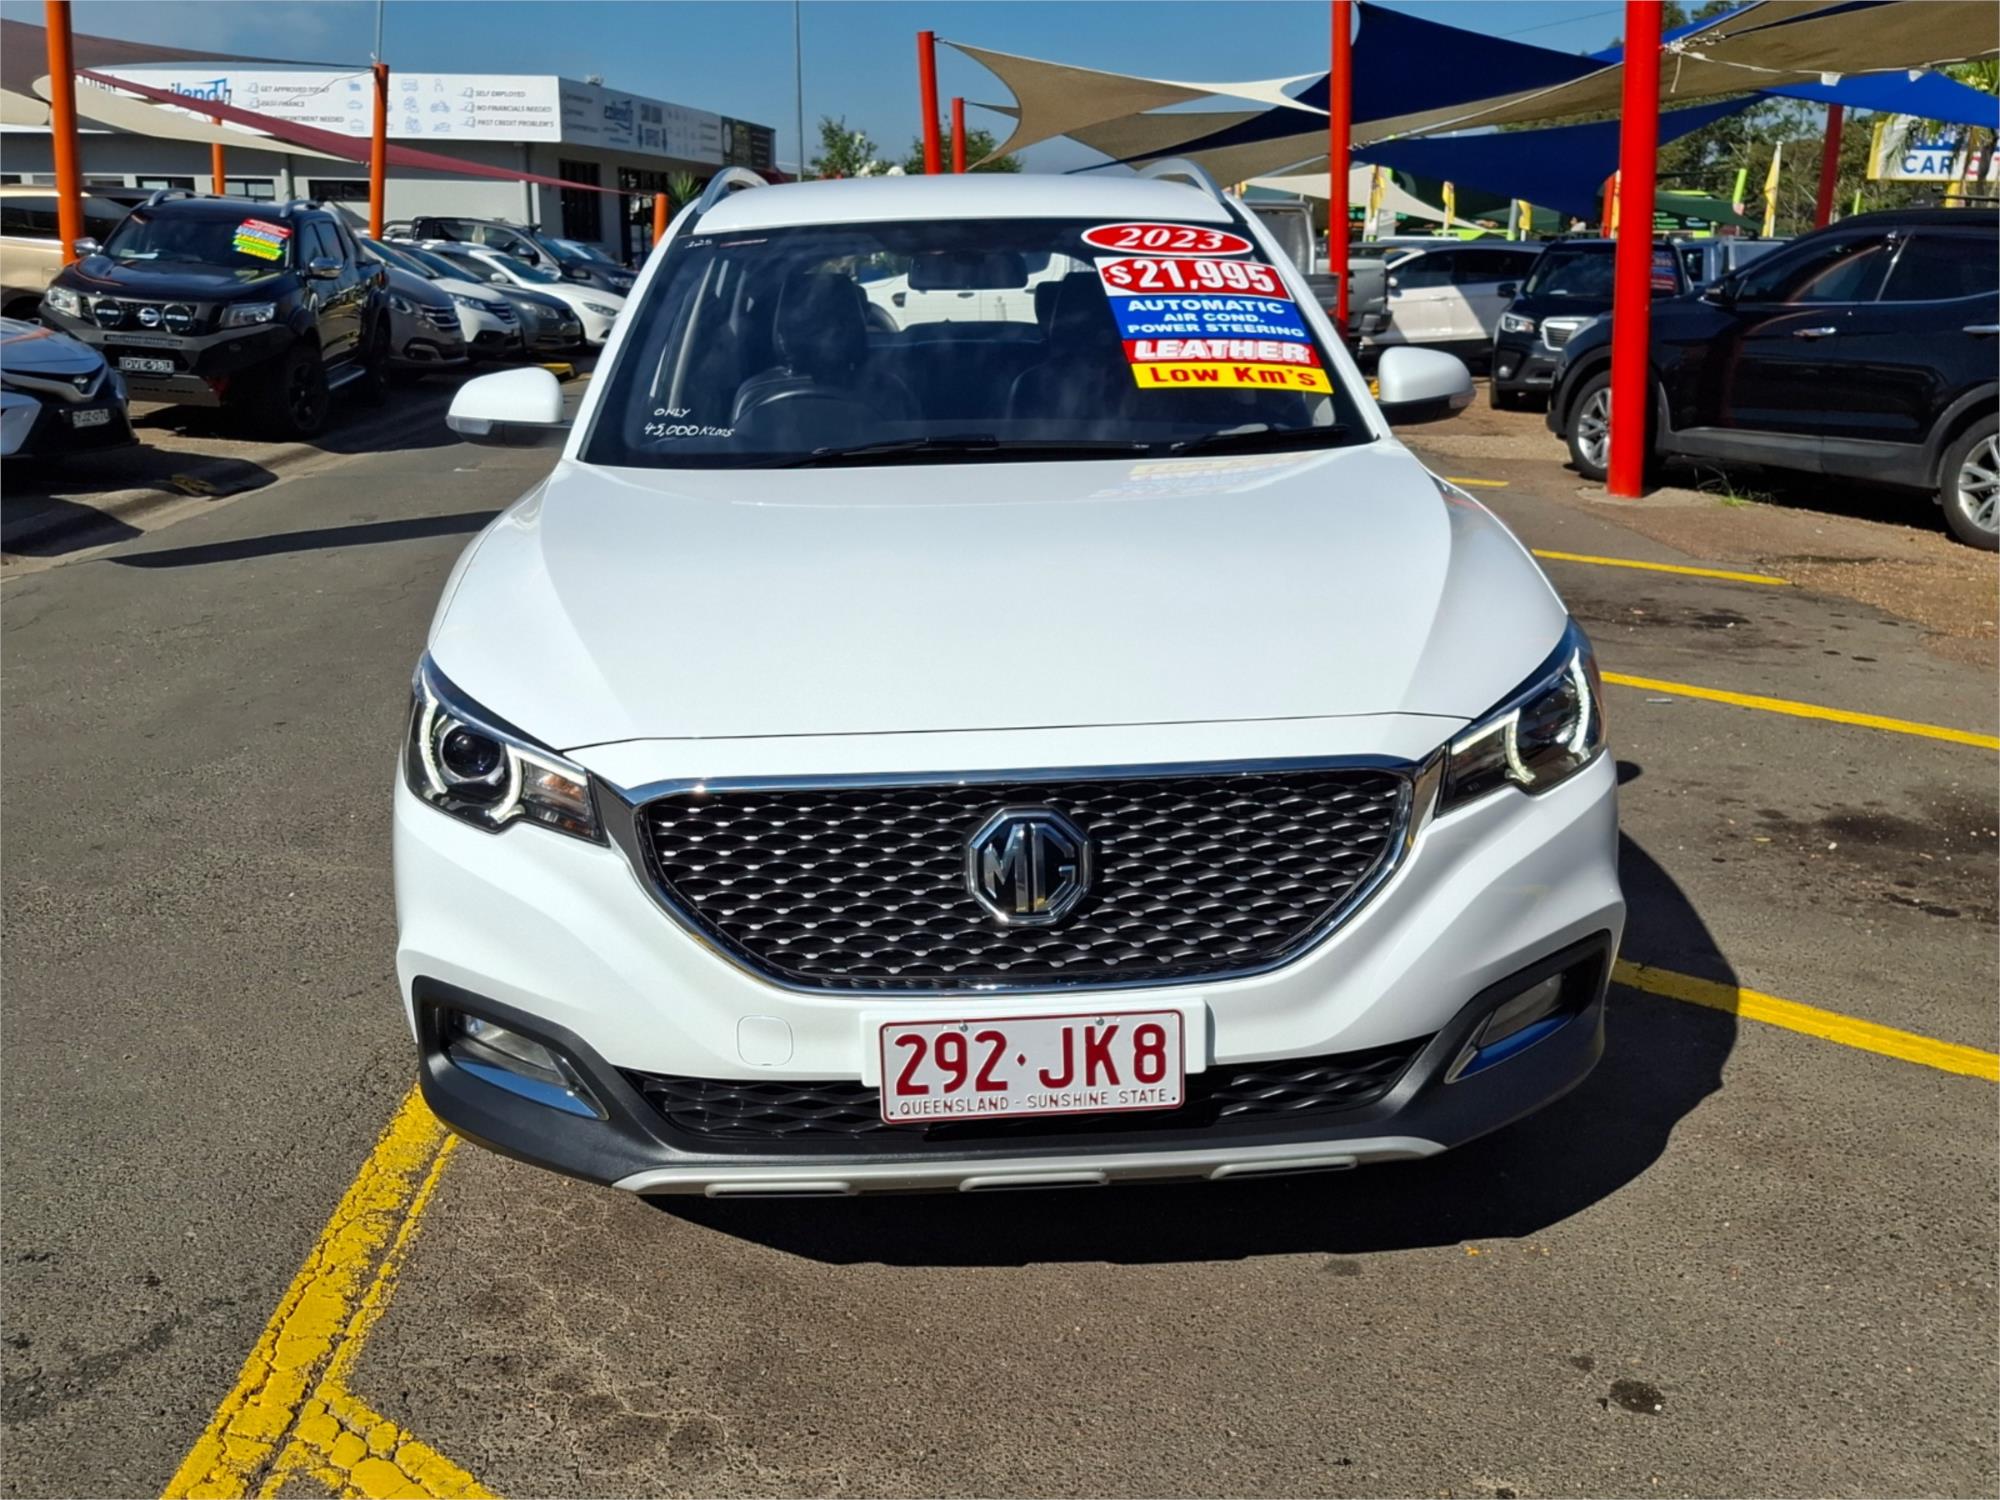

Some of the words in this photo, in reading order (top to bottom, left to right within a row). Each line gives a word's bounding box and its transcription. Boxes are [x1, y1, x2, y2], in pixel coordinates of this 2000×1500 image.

[1902, 155, 1954, 174] CAR
[1114, 228, 1225, 250] 2023
[1108, 260, 1275, 293] $21,995
[1127, 299, 1286, 315] AUTOMATIC
[1163, 313, 1199, 322] AIR
[1203, 313, 1266, 324] COND.
[1127, 323, 1201, 334] POWER
[1205, 323, 1306, 338] STEERING
[1134, 339, 1312, 364] LEATHER
[653, 407, 692, 418] ONLY
[983, 822, 1076, 913] MG
[899, 1096, 1009, 1116] QUEENSLAND
[1026, 1091, 1109, 1109] SUNSHINE
[1118, 1088, 1167, 1105] STATE
